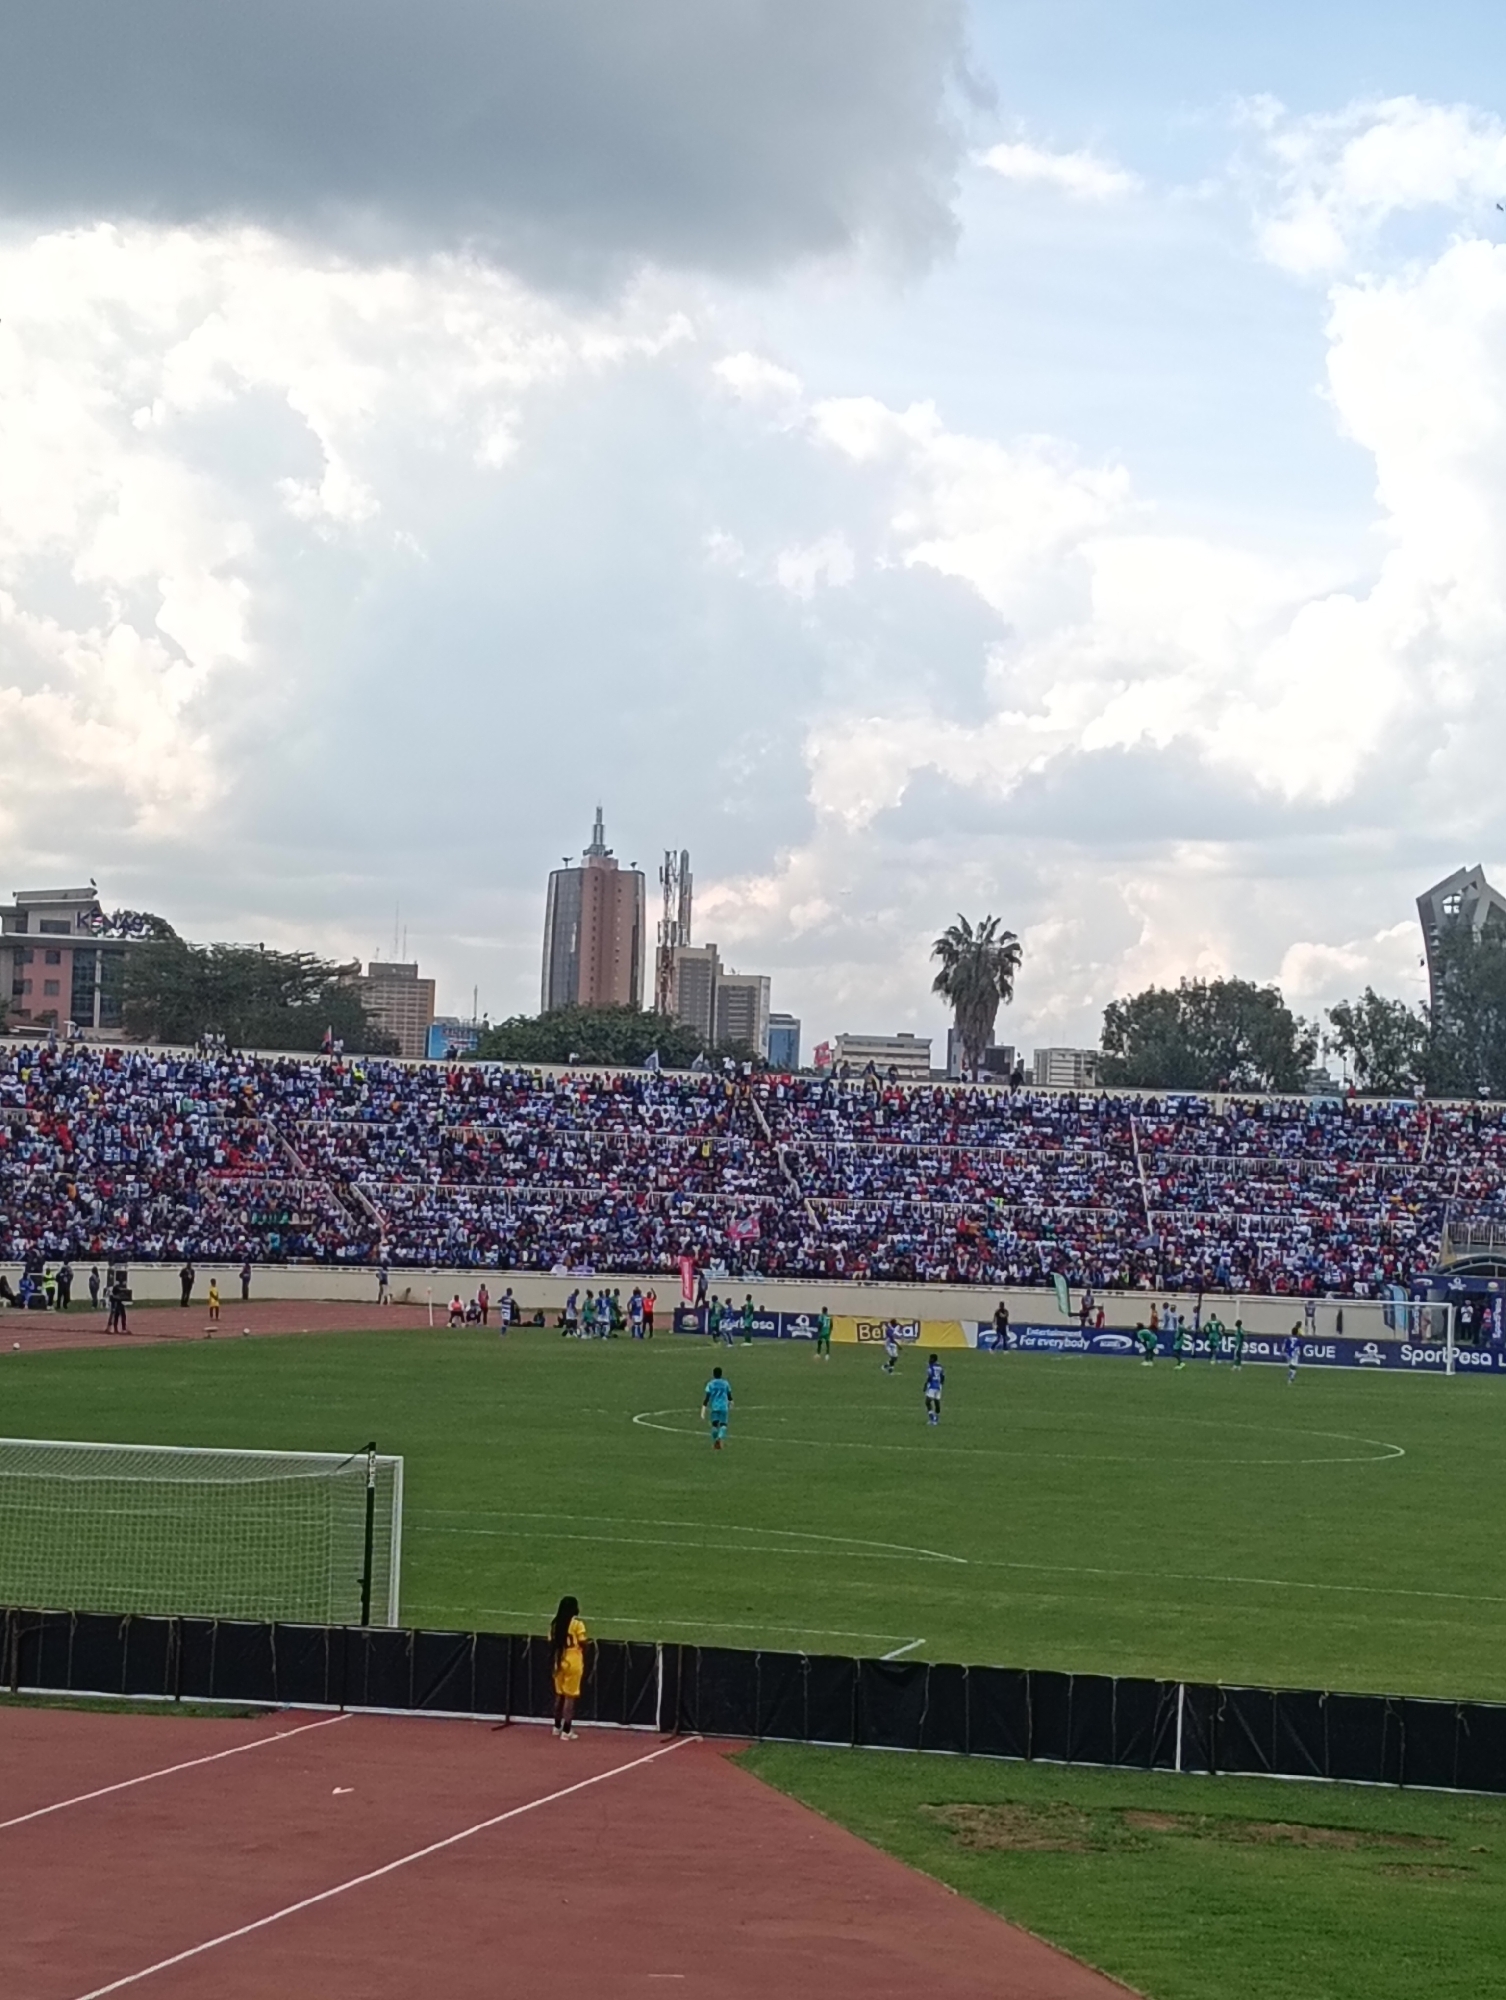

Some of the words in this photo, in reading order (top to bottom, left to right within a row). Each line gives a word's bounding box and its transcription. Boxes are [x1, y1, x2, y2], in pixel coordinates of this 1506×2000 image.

[1019, 1335, 1037, 1347] For
[1273, 1342, 1337, 1359] LGUE
[1400, 1344, 1493, 1366] SportPesa
